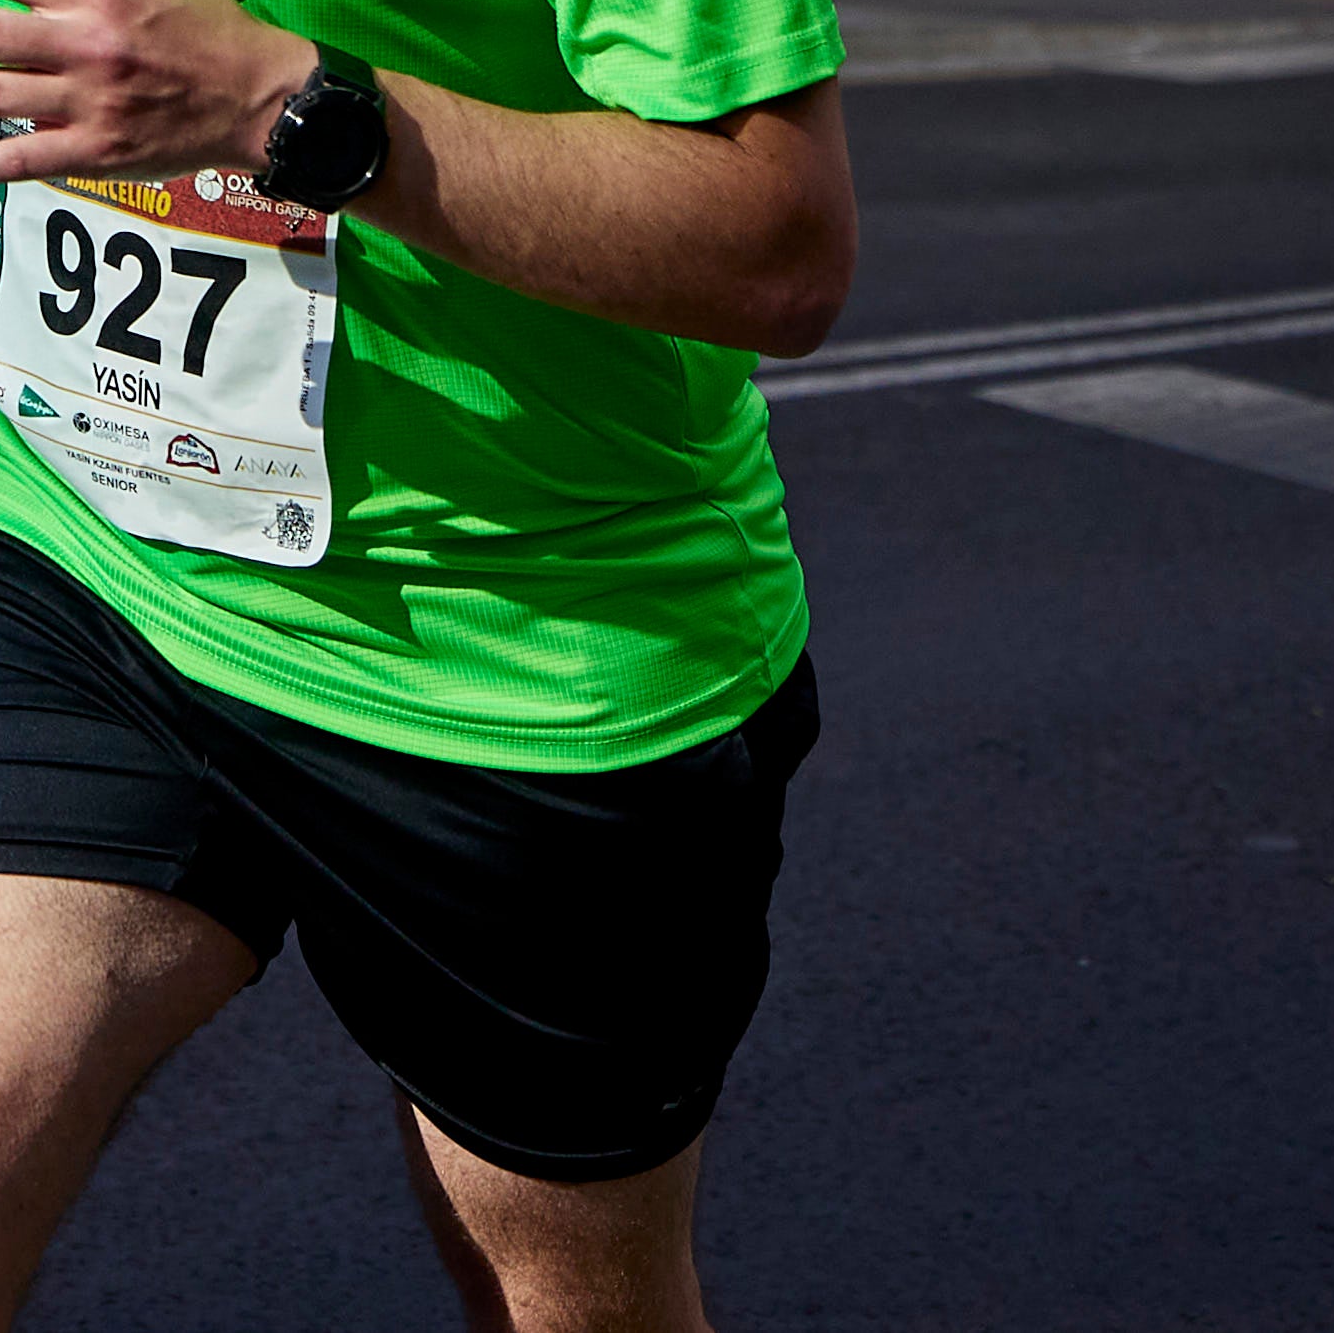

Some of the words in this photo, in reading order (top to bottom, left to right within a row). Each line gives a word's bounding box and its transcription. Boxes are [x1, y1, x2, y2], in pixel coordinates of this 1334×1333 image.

[224, 194, 272, 213] NIPPON
[275, 203, 318, 221] GASES
[39, 208, 247, 377] 927
[92, 362, 161, 411] YASÍN
[93, 417, 150, 442] OXIMESA
[126, 467, 171, 485] FUENTES
[234, 455, 308, 479] ANAYA
[91, 471, 138, 494] SENIOR
